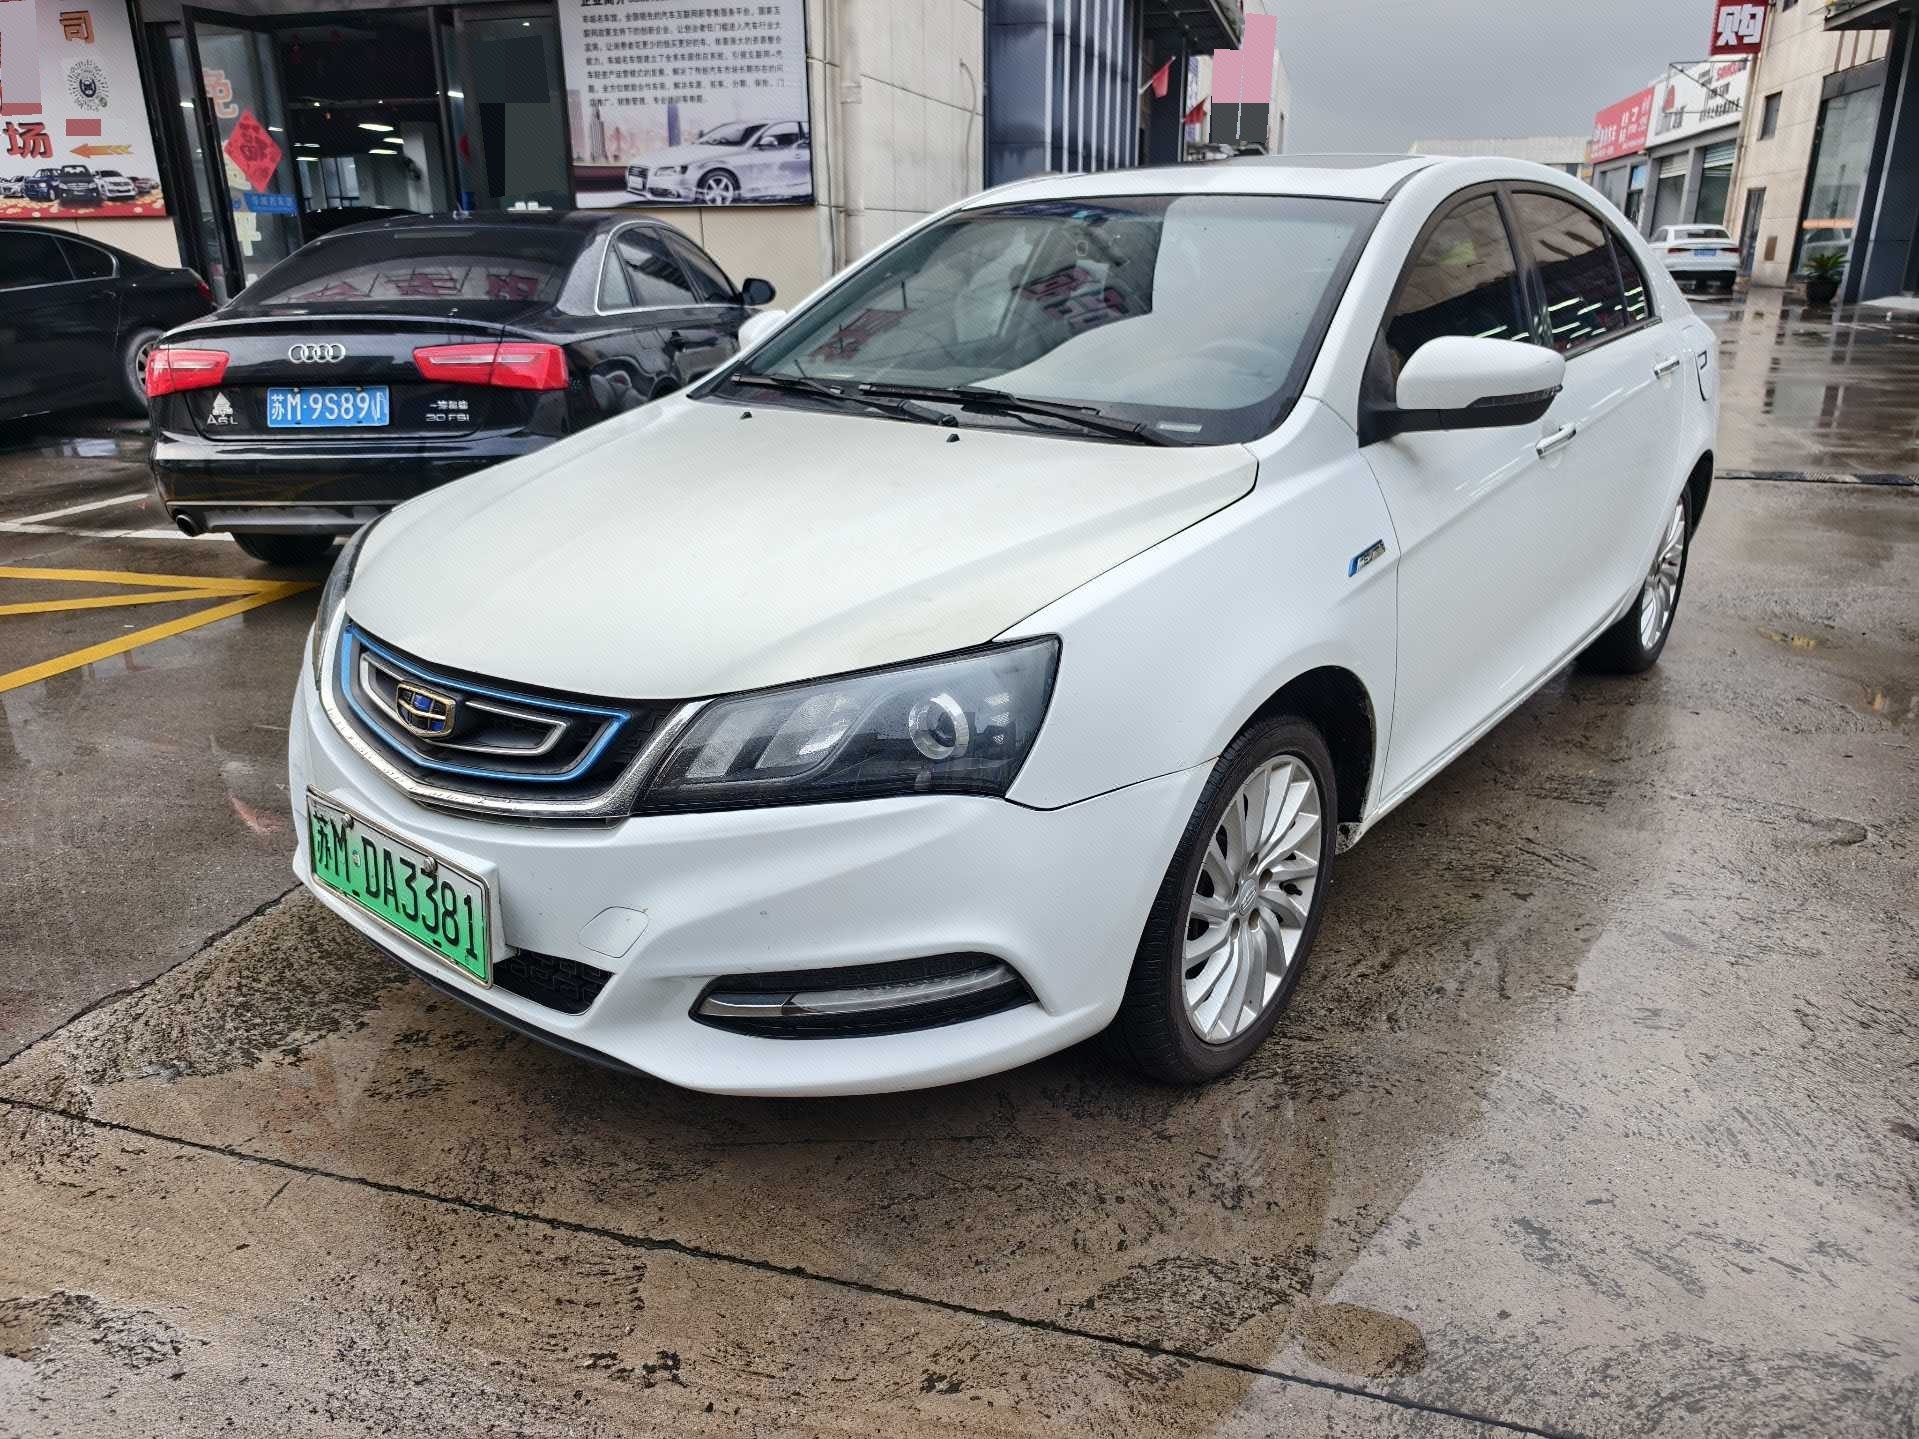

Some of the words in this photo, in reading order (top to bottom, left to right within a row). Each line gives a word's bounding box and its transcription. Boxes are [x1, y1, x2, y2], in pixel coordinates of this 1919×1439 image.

[59, 10, 95, 45] 司
[1715, 3, 1765, 46] 购
[3, 121, 53, 158] 场
